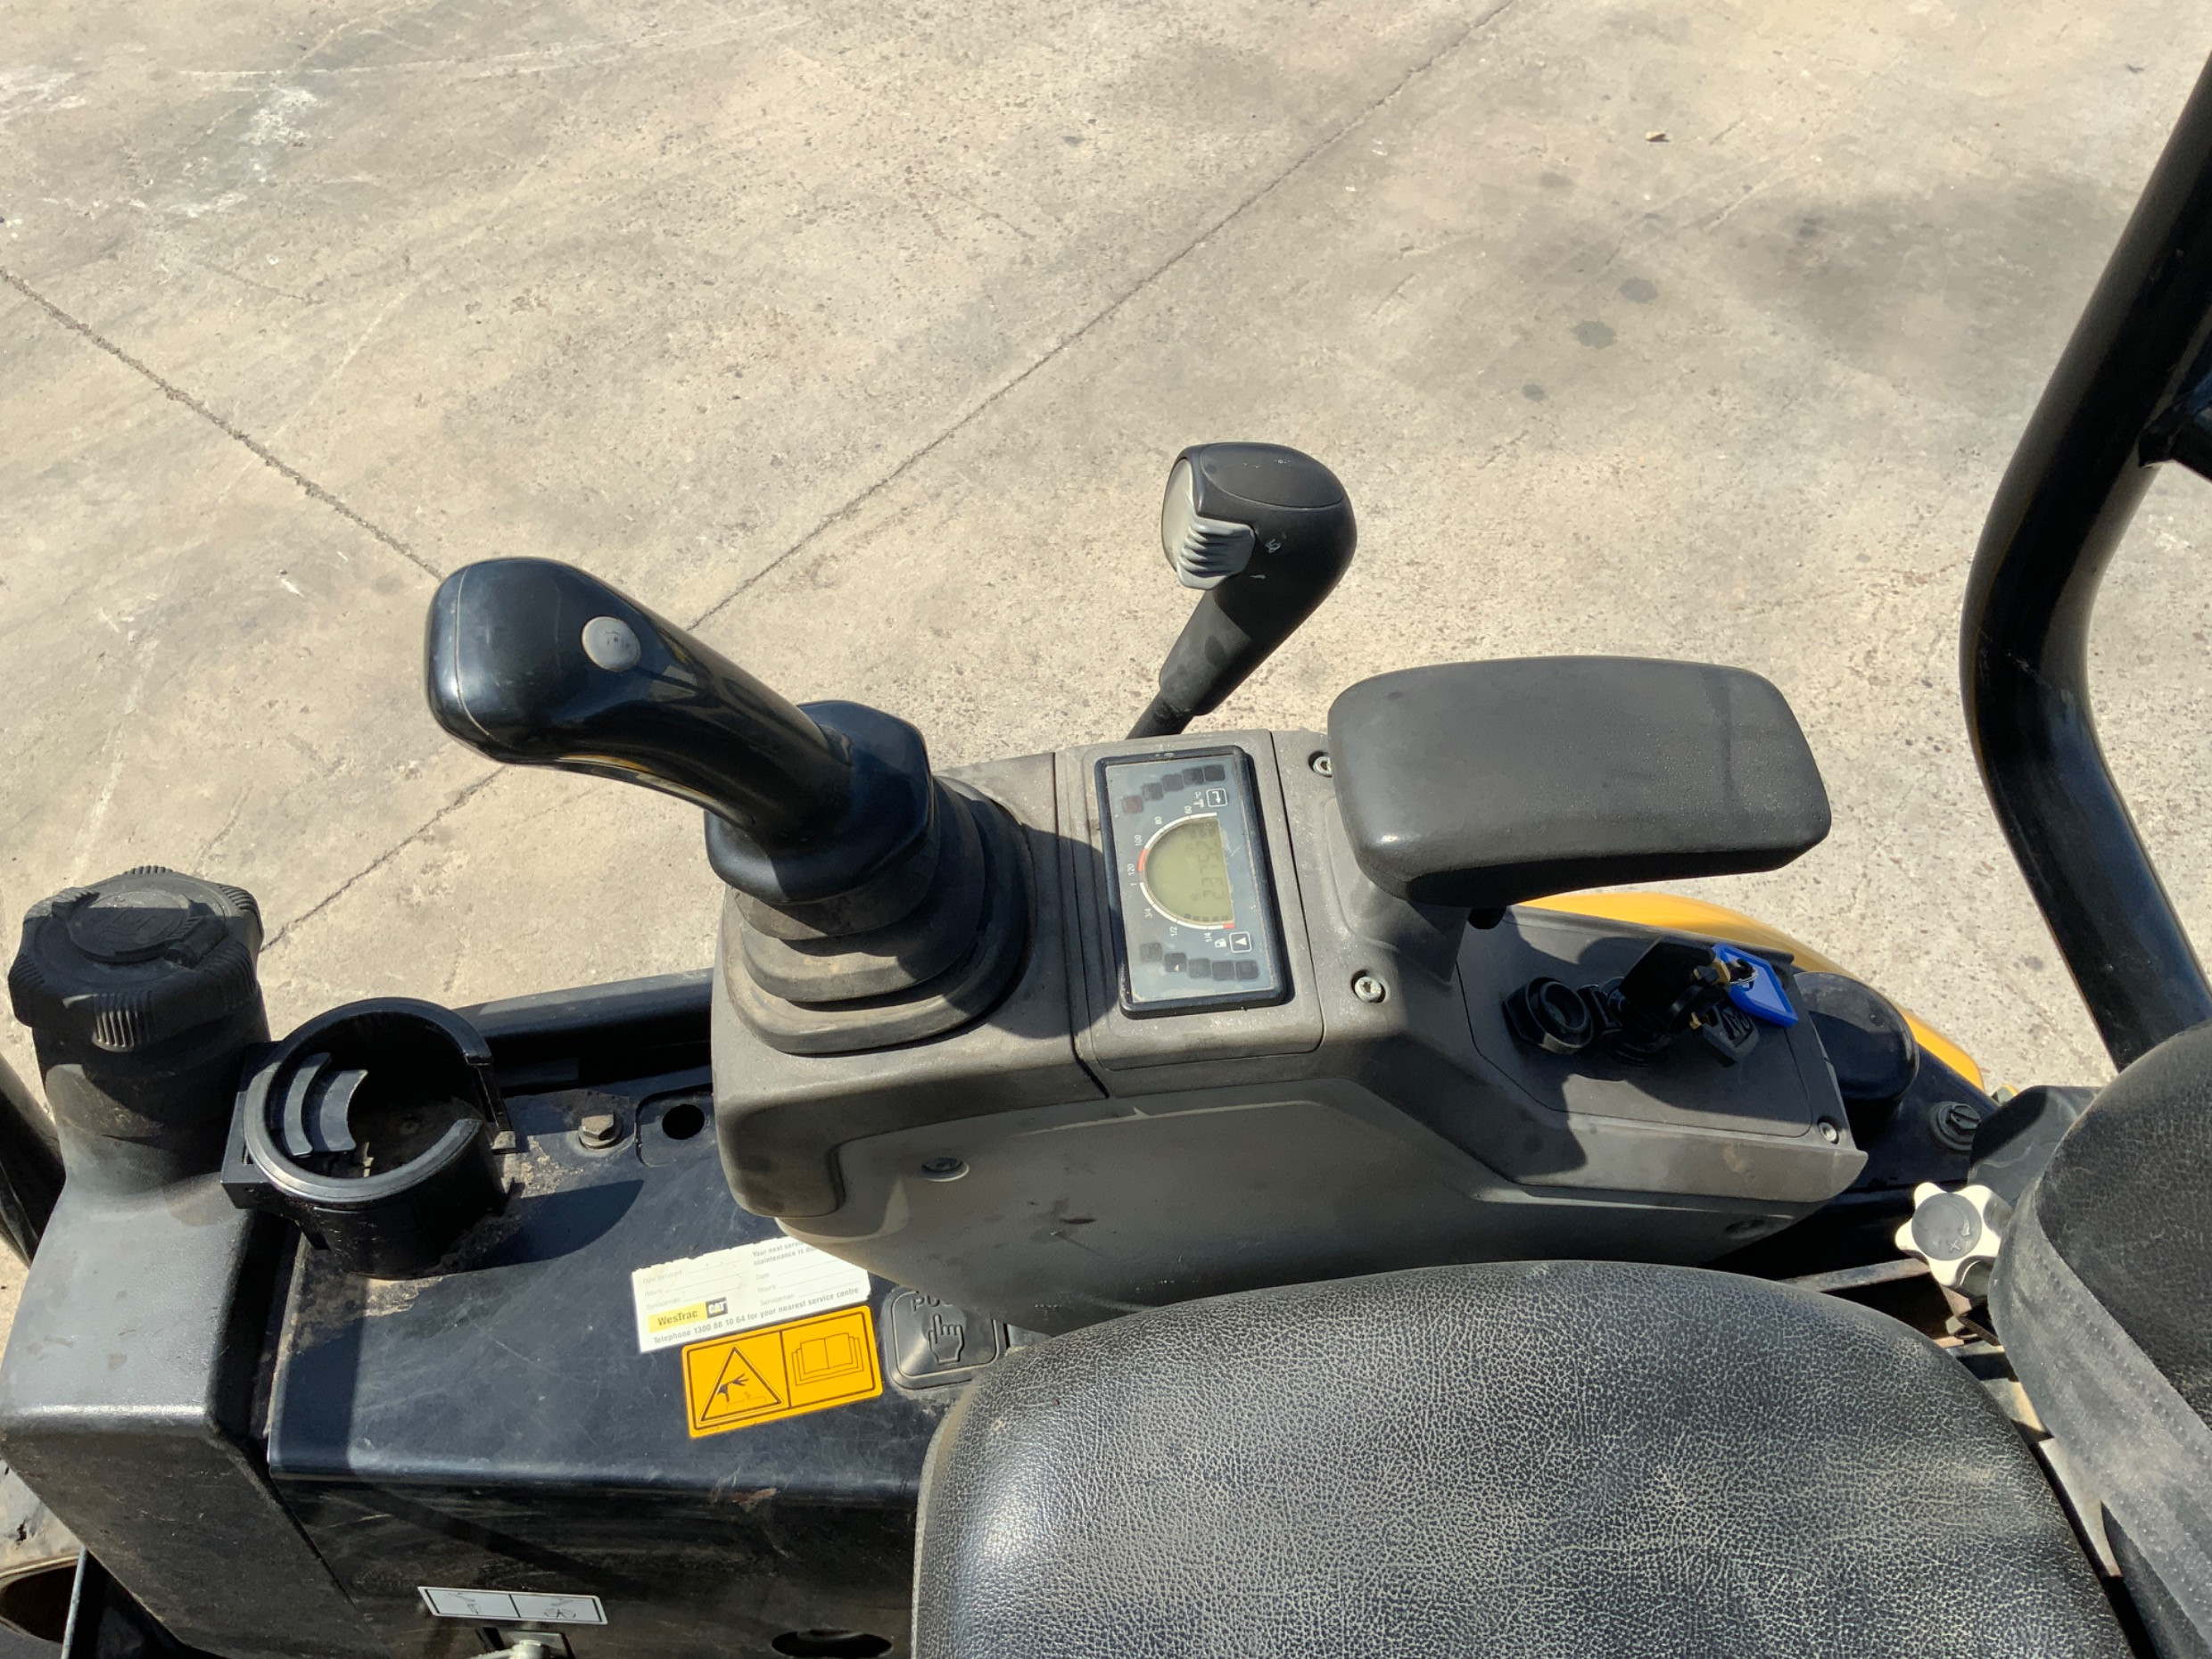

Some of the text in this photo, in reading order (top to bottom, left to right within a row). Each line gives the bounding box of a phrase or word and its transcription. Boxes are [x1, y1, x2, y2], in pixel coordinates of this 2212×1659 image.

[1184, 805, 1193, 814] 60
[1154, 816, 1163, 825] 80
[1134, 834, 1142, 846] 100
[1127, 863, 1135, 876] 120
[1144, 908, 1153, 920] 3/4
[1169, 925, 1178, 937] 1/2
[1203, 932, 1213, 943] 1/4
[752, 1250, 766, 1258] Your
[768, 1244, 783, 1253] next
[708, 1300, 726, 1315] CAT
[911, 1295, 953, 1311] PU
[653, 1287, 859, 1344] Telephone 1300 88 10 64 for your nearest service centre
[657, 1310, 698, 1326] WesTrac
